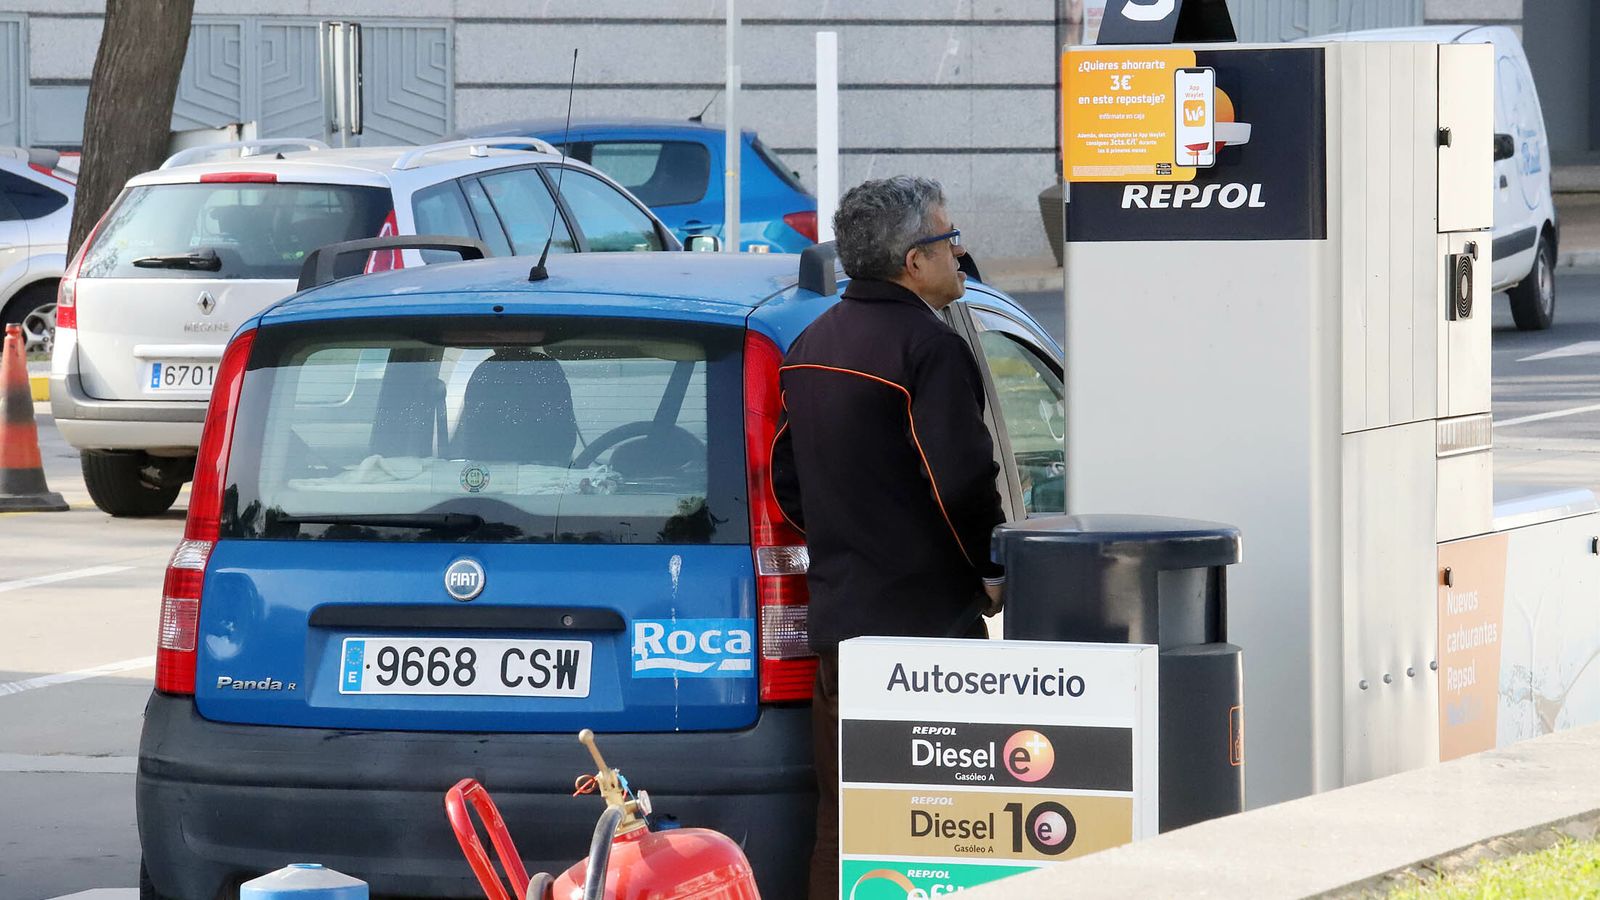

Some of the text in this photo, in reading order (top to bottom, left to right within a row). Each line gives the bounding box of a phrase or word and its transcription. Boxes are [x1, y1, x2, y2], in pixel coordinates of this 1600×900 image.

[1078, 60, 1166, 72] ¿Quieres ahorrarte
[1078, 93, 1166, 106] en este repostaje?
[1121, 183, 1266, 209] REPSOL
[184, 322, 231, 333] MEGANE
[450, 572, 478, 586] FIAT
[1447, 590, 1478, 615] Nuevos
[633, 622, 751, 658] Roca
[1447, 621, 1497, 654] carburantes
[348, 646, 580, 690] E 9668 CSW
[216, 675, 297, 691] Panda R
[887, 662, 1086, 697] Autoservicio
[1447, 659, 1477, 695] Repsol
[912, 726, 957, 736] REPSOL
[912, 738, 995, 769] Diesel
[954, 772, 995, 782] Gasóleo A
[911, 796, 954, 806] REPSOL
[911, 810, 995, 840] Diesel
[954, 844, 994, 854] Gasóleo A
[907, 869, 950, 879] REPSOL
